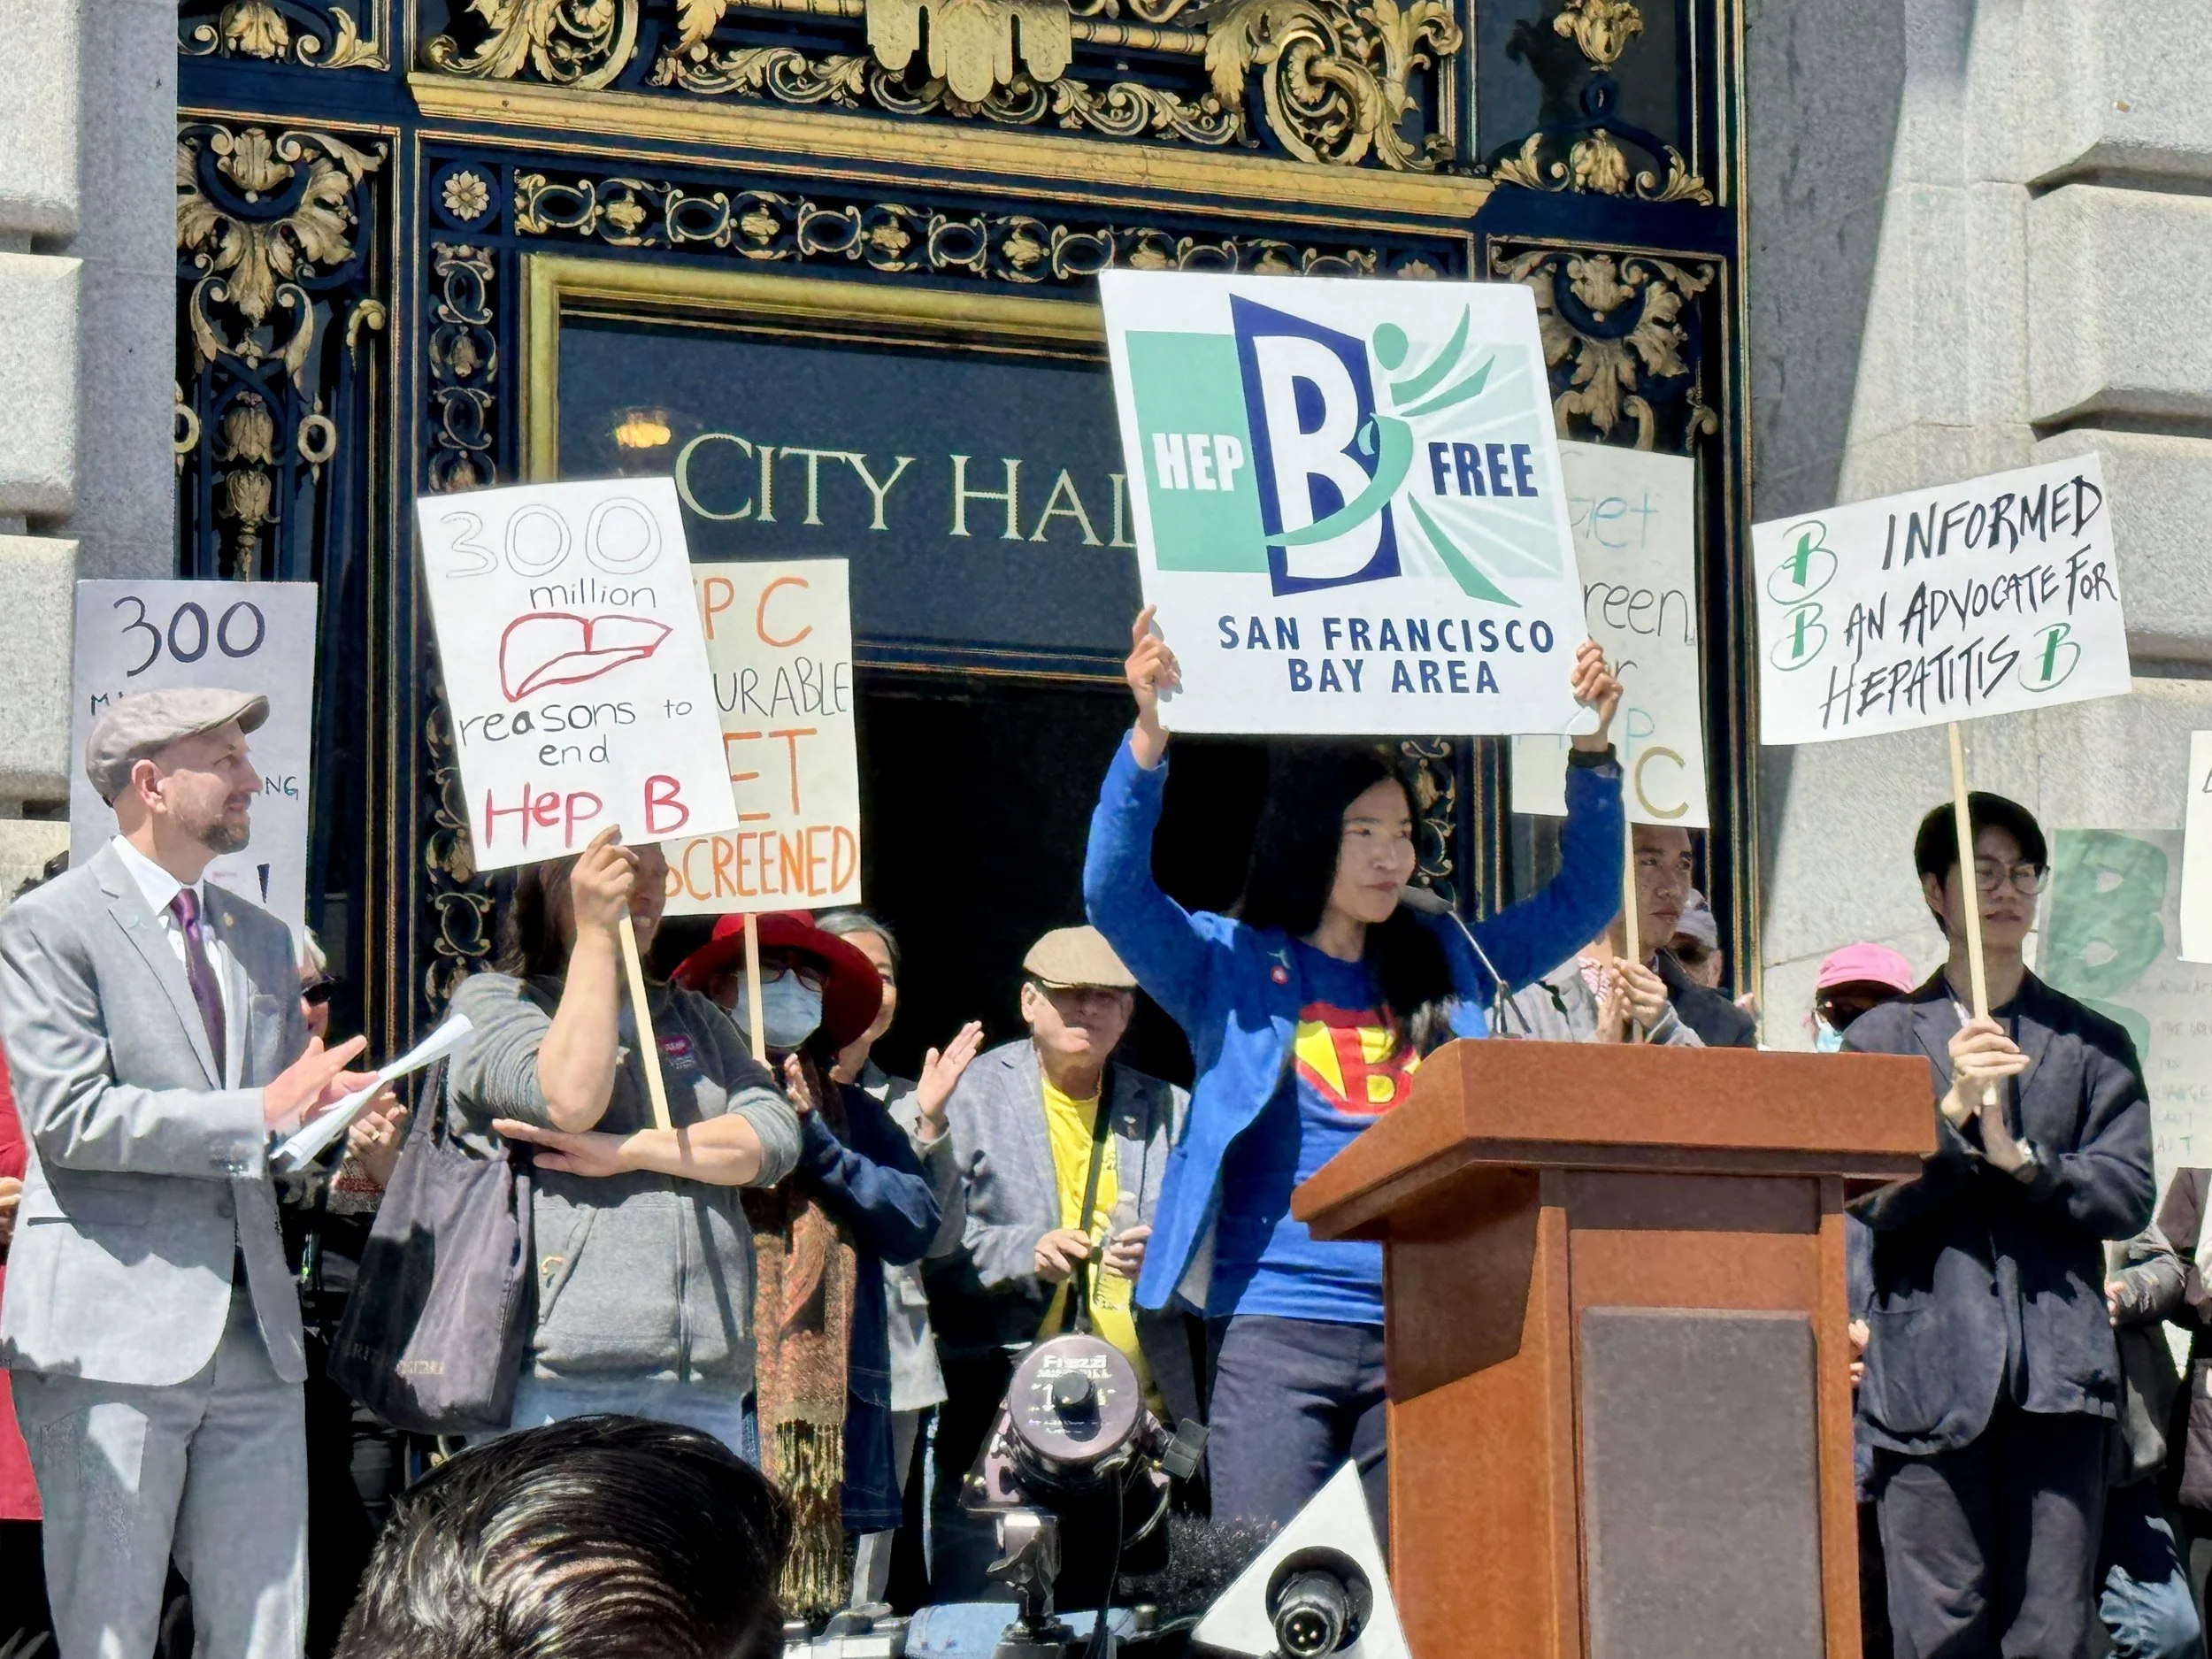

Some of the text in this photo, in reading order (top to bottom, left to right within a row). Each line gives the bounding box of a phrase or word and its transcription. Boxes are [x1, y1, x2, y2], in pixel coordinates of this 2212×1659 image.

[674, 433, 1137, 549] CITY HAL
[1152, 335, 1540, 580] HEP B FREE
[441, 496, 662, 579] 300
[1768, 474, 2103, 604] B INFORMED
[529, 578, 657, 609] million
[694, 576, 813, 648] P C
[1583, 581, 1688, 643] reen
[1770, 602, 1828, 672] B
[1843, 591, 1887, 662] AN
[1899, 564, 2060, 648] ADVOCATE
[113, 595, 265, 678] 300
[1217, 615, 1555, 653] SAN FRANCISCO
[713, 657, 849, 717] URABLE
[1288, 658, 1501, 695] BAY AREA
[1818, 622, 2082, 730] HEPATITIS B
[458, 699, 693, 747] reasons to
[538, 733, 611, 767] end
[485, 774, 690, 849] Hep B
[723, 727, 818, 821] ET
